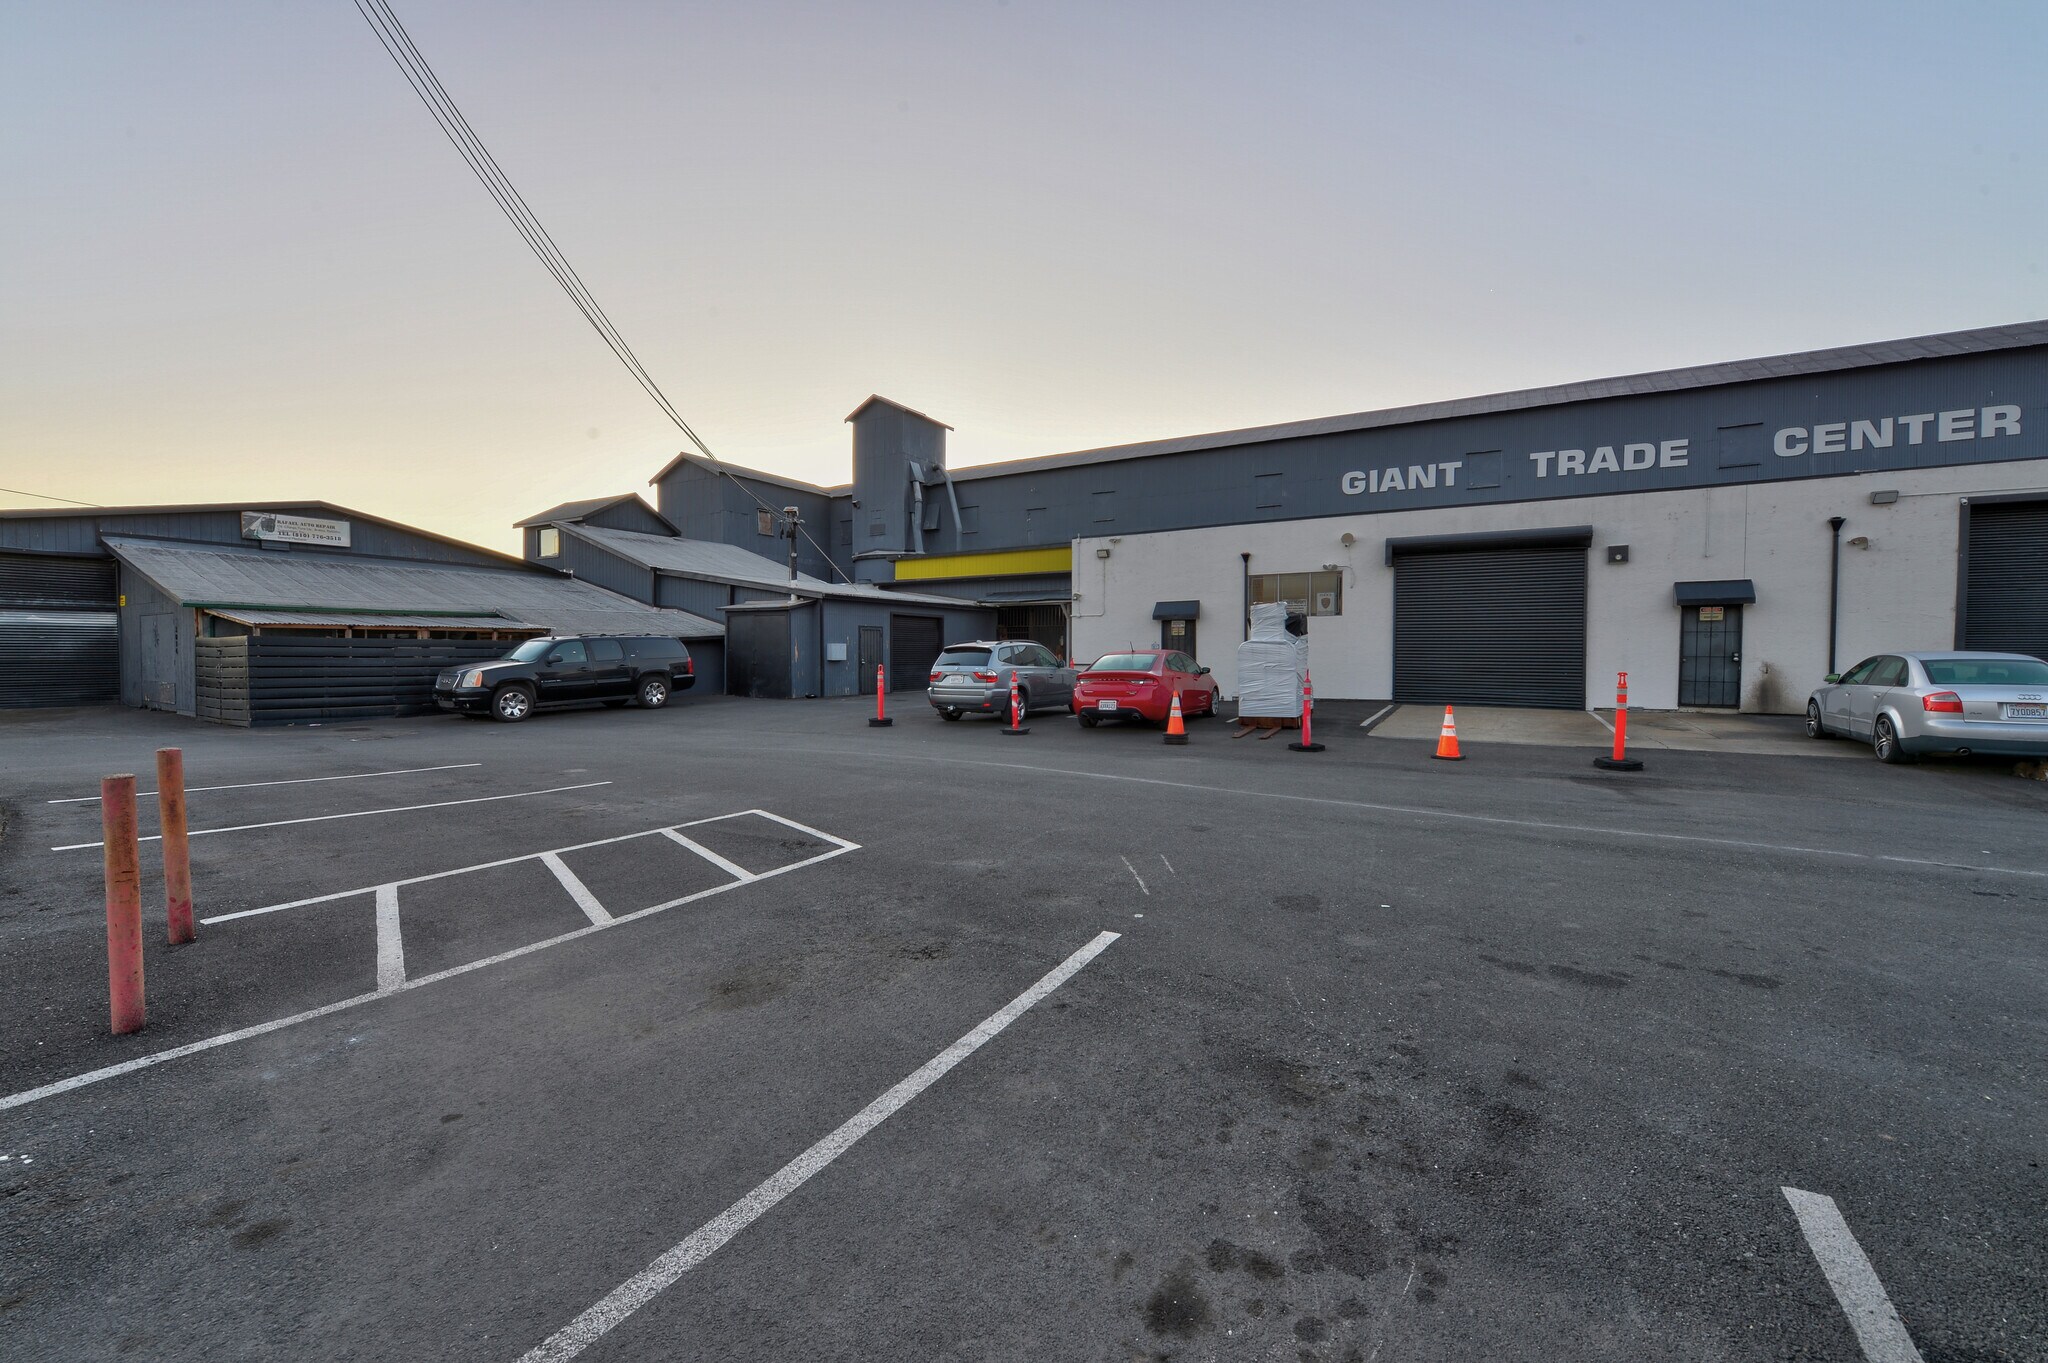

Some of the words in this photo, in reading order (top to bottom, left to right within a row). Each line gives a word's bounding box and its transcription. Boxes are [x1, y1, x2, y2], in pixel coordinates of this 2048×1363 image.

[1341, 461, 1463, 495] GIANT
[1529, 438, 1689, 478] TRADE
[1773, 404, 2022, 457] CENTER
